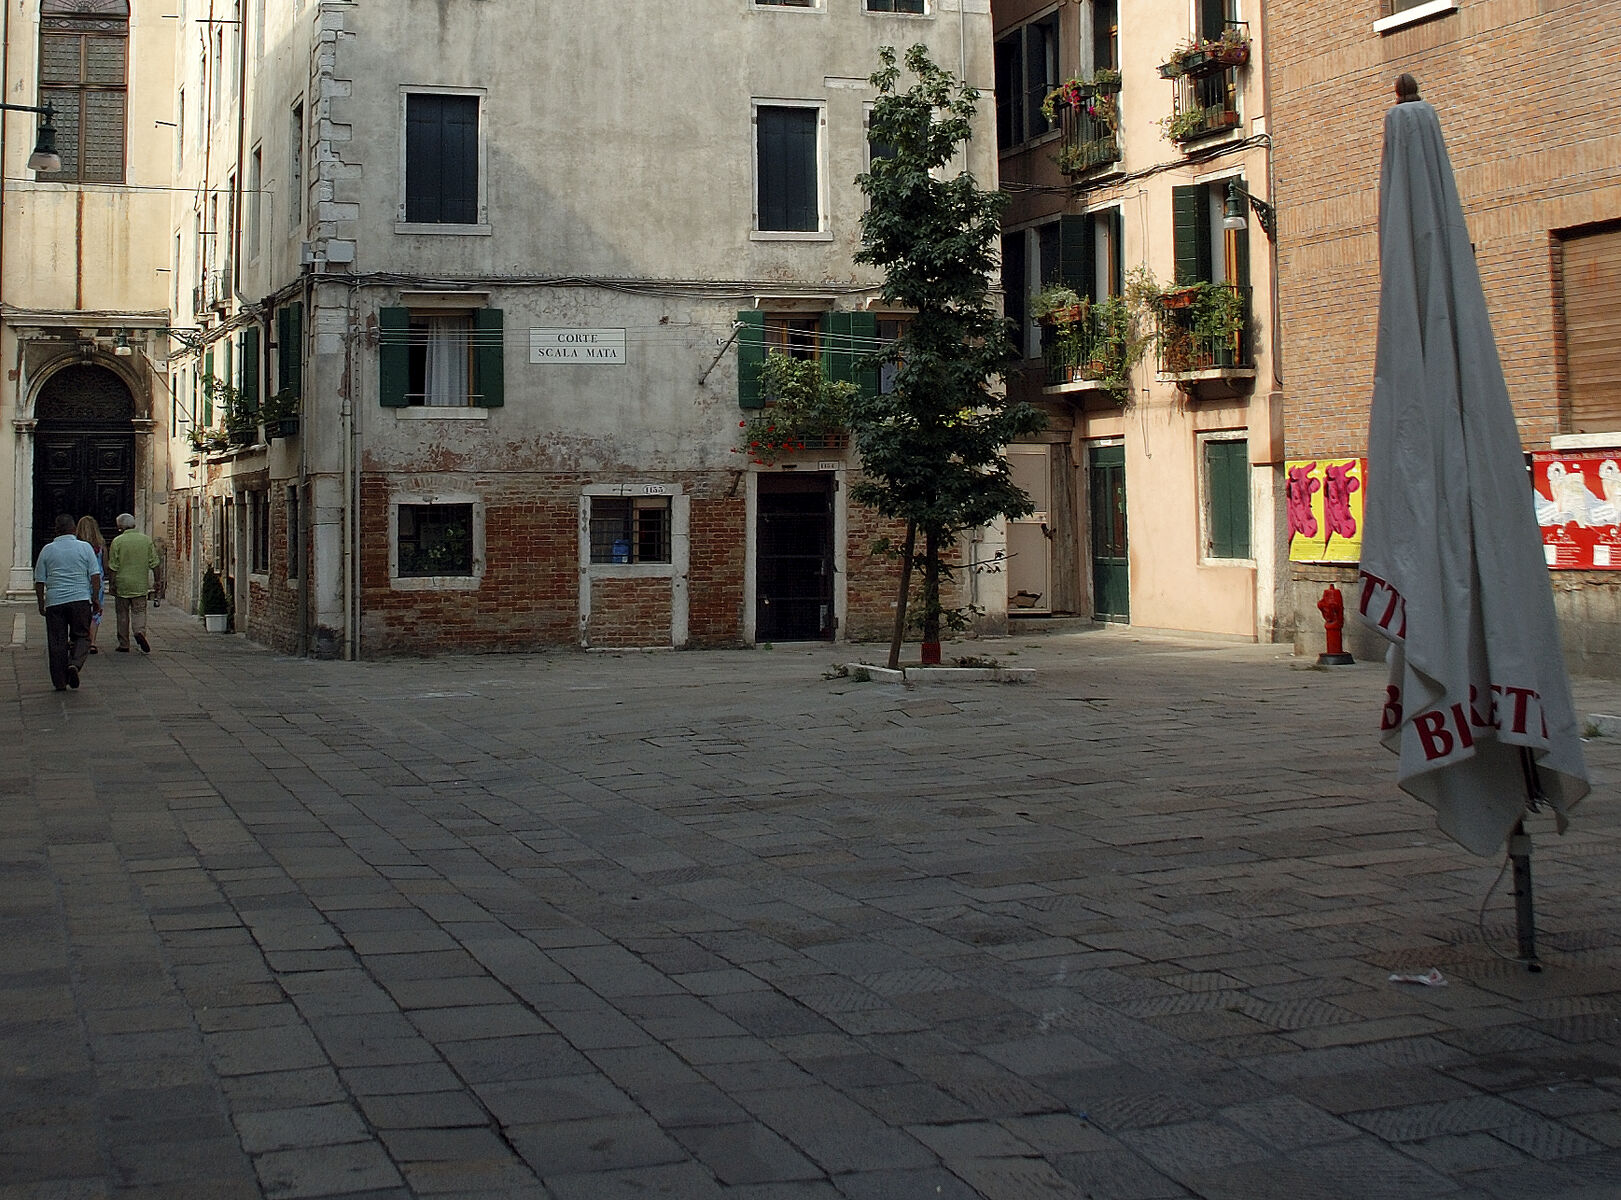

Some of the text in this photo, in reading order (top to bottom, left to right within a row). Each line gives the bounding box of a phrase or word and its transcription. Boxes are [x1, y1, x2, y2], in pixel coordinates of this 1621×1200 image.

[557, 334, 598, 343] CORTE
[538, 348, 617, 358] SCALA MATA
